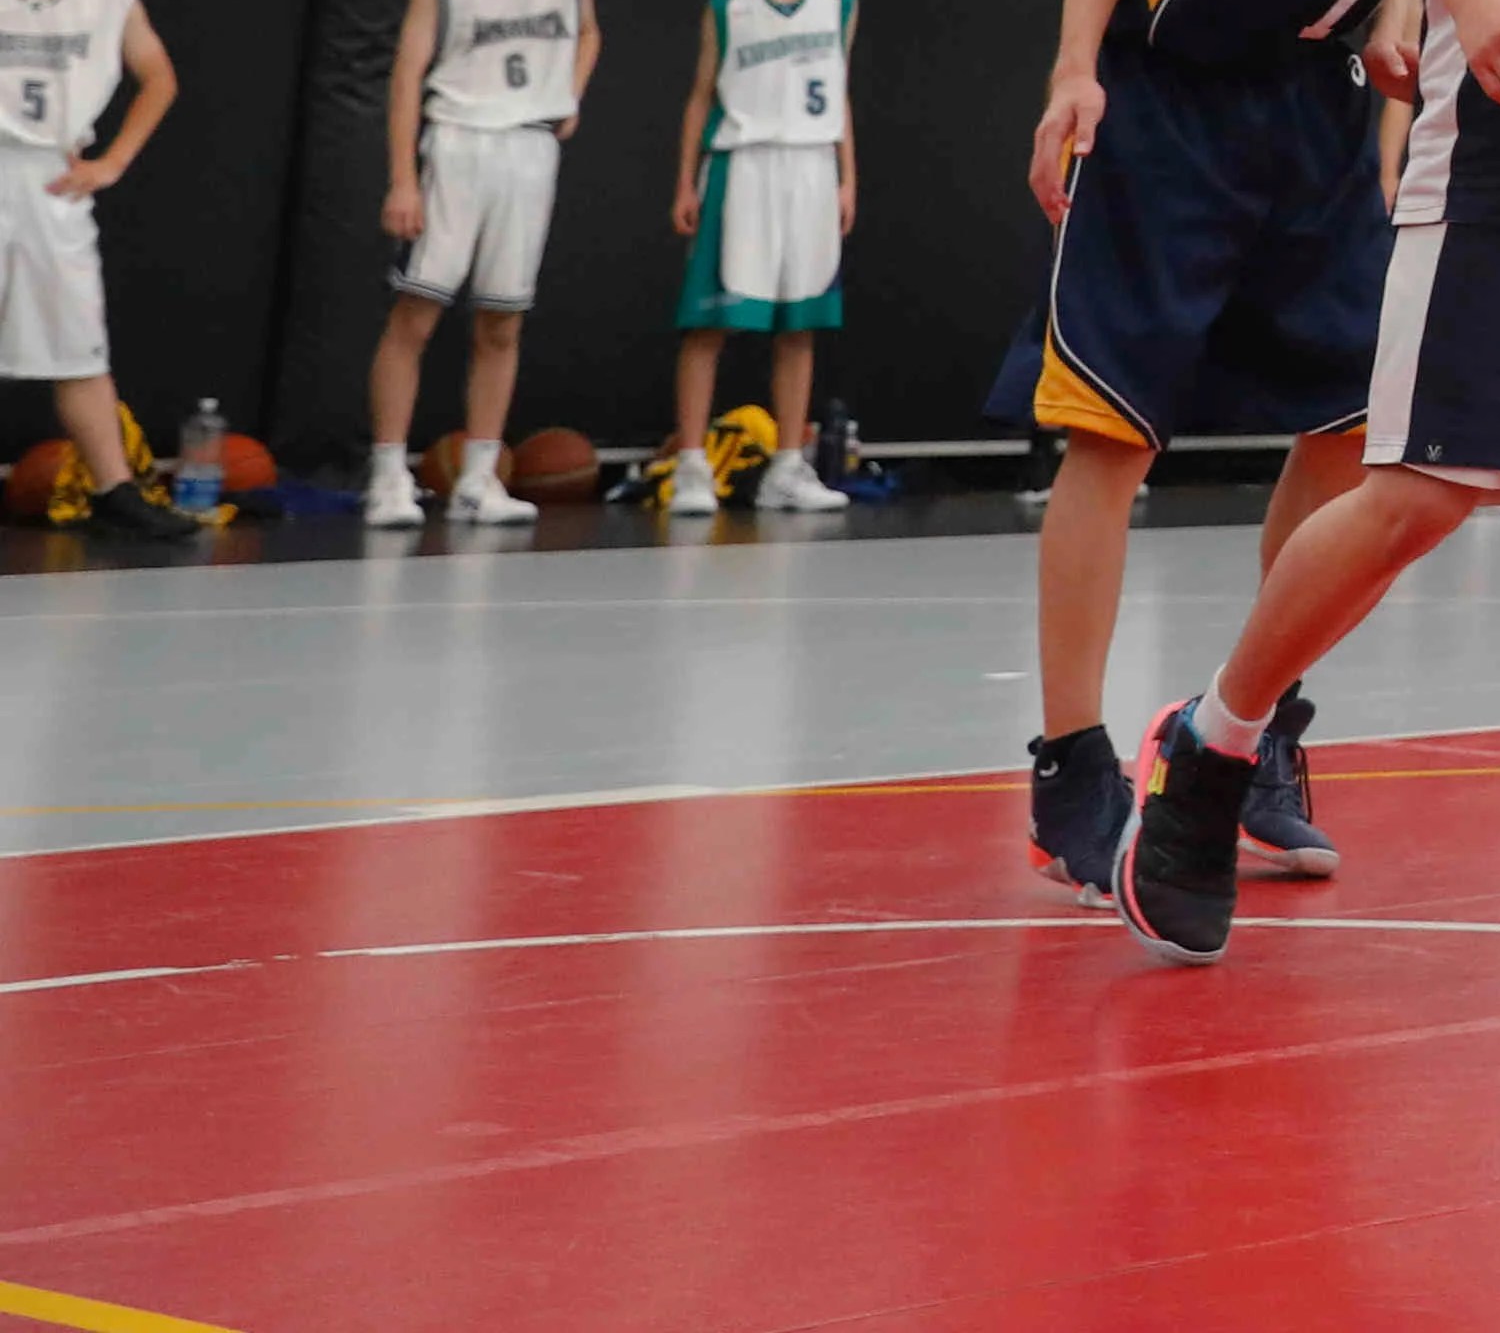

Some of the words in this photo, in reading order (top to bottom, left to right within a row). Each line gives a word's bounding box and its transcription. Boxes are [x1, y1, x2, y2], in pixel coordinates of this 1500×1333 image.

[505, 52, 529, 89] 6
[21, 80, 46, 121] 5
[806, 79, 827, 116] 5
